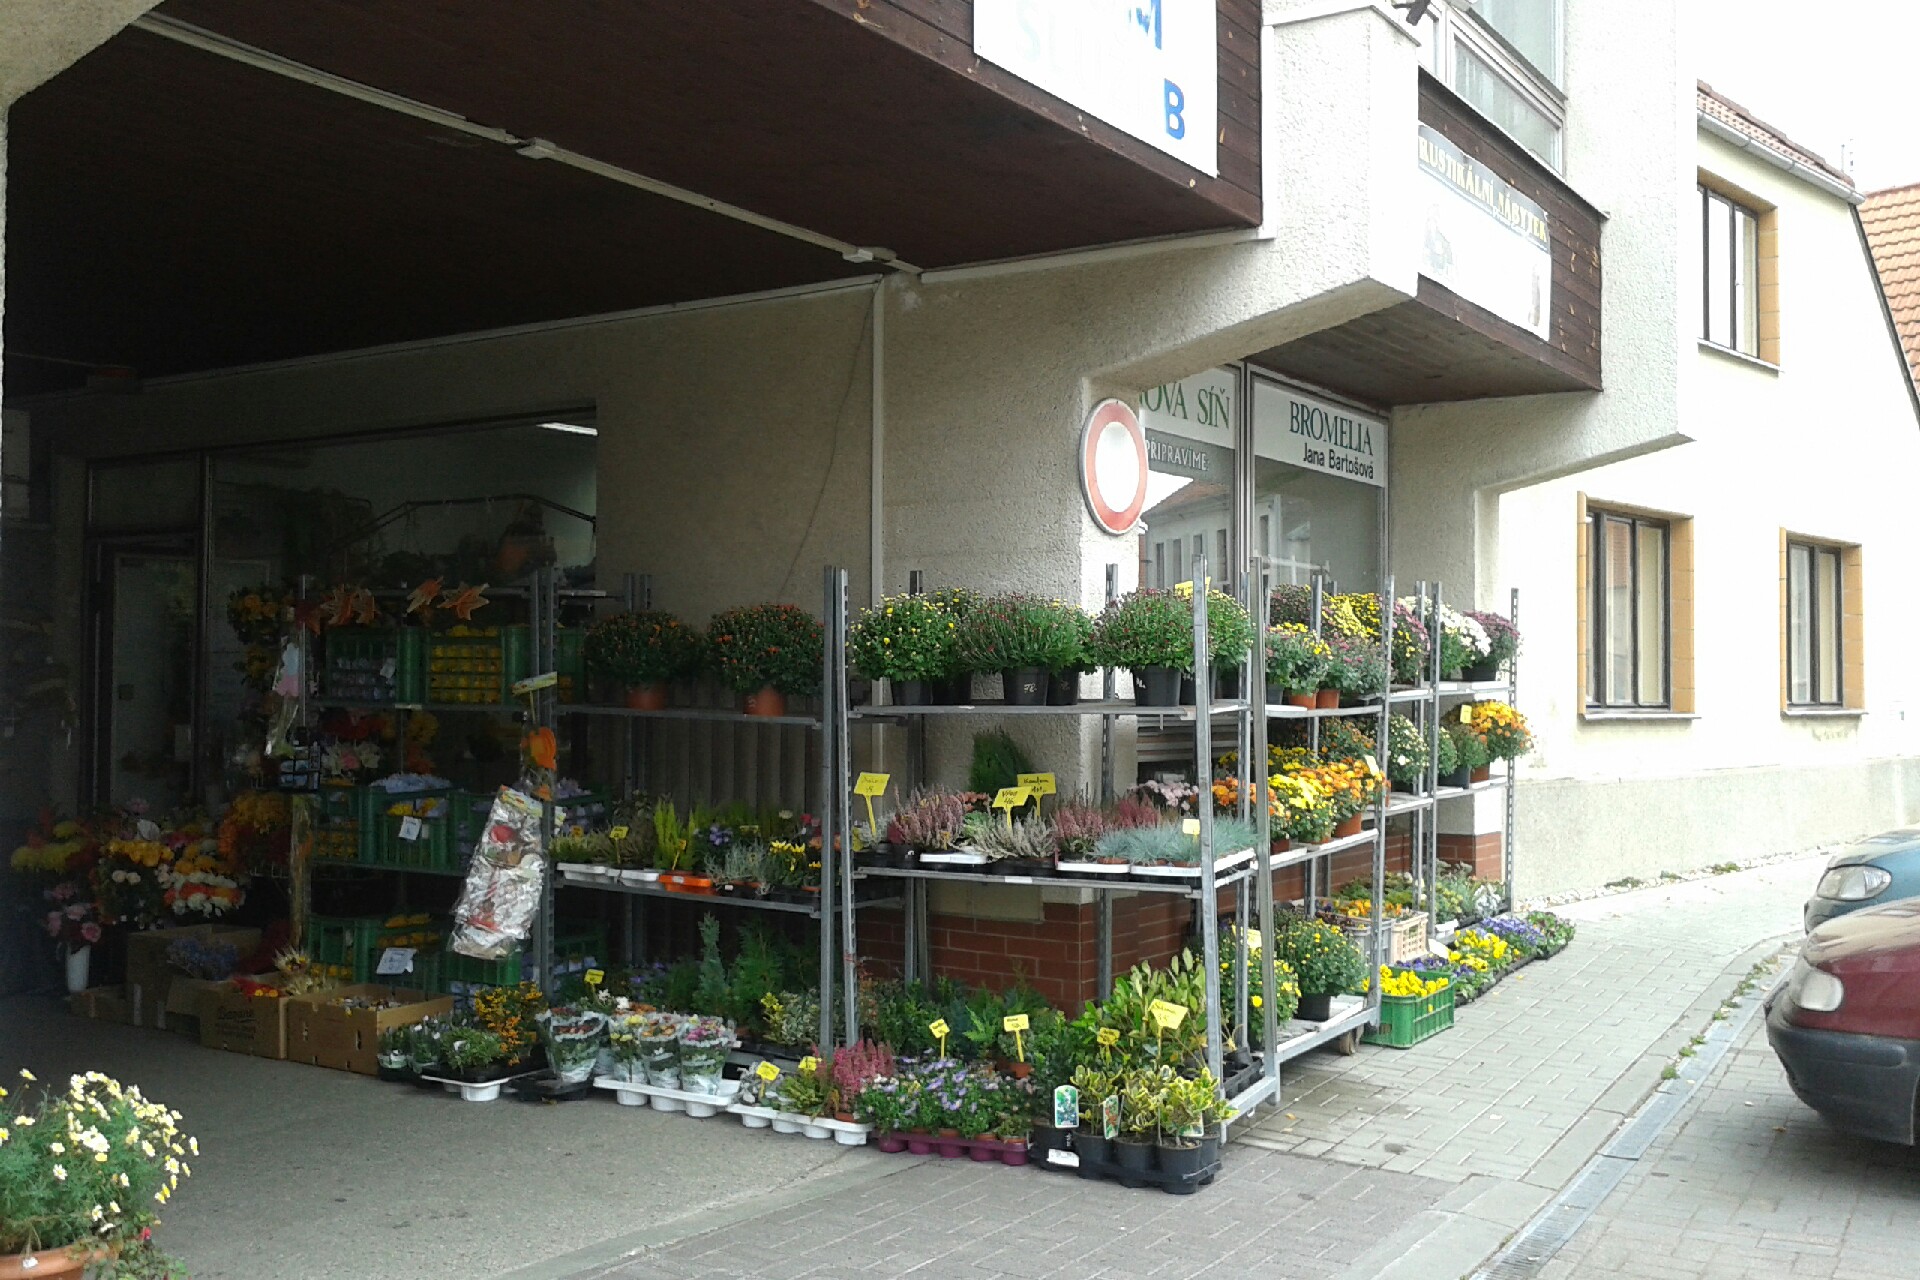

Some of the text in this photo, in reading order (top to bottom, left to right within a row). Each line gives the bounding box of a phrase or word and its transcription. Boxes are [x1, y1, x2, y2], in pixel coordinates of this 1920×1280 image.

[1417, 136, 1494, 208] RUSTIKÁLNÍ
[1497, 191, 1548, 243] NÁBYTEK
[1197, 385, 1231, 430] SÍŇ
[1289, 400, 1374, 457] BROMELIA
[1303, 442, 1374, 480] Jana Bartošová
